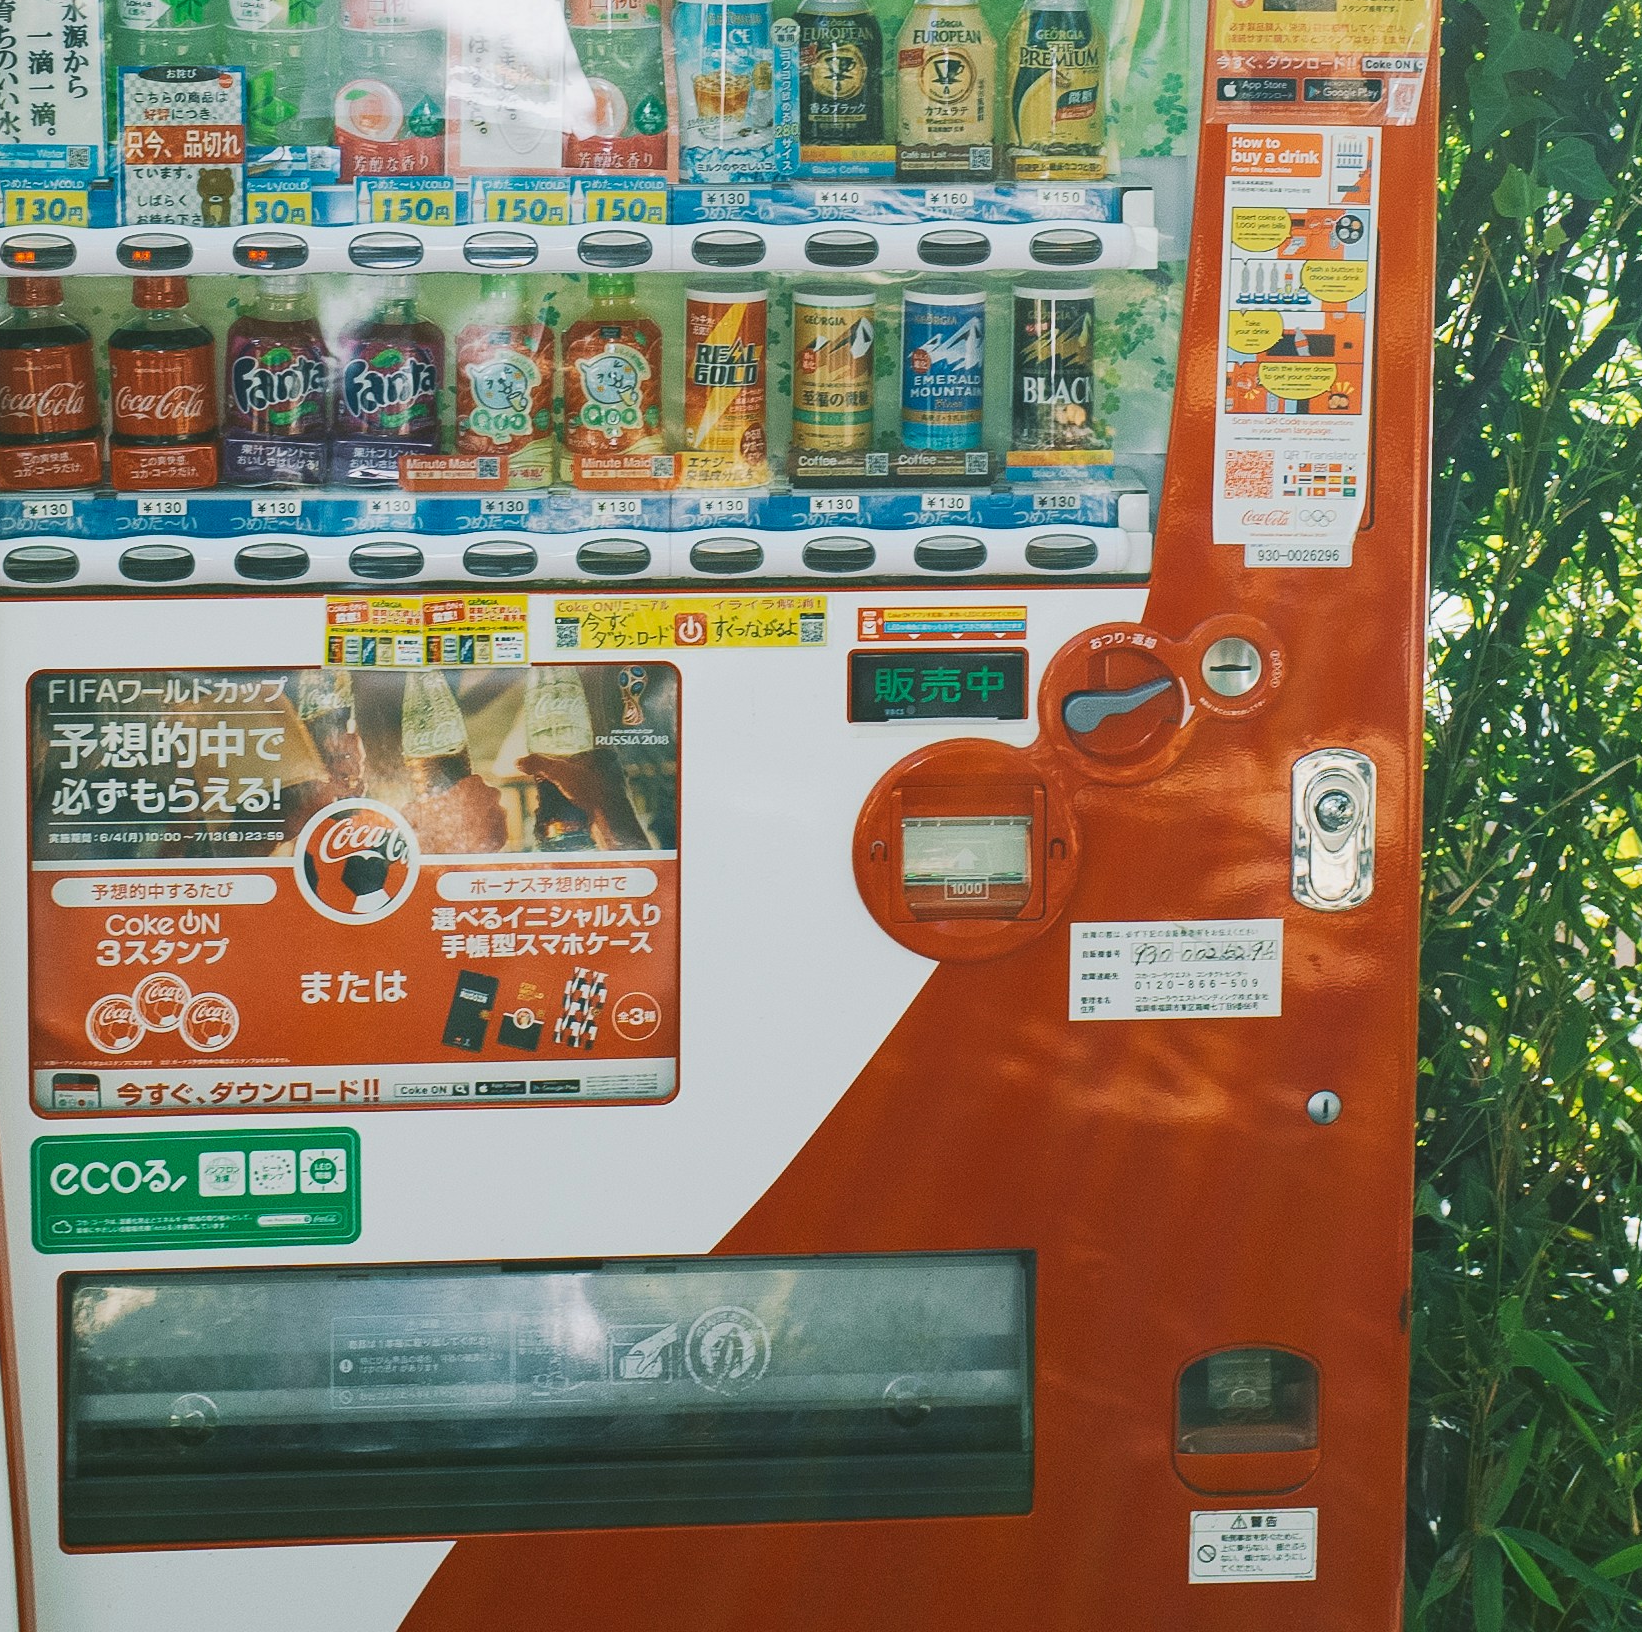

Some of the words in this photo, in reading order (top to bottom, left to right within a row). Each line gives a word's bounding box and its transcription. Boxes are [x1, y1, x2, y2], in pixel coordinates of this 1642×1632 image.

[913, 30, 982, 44] EUROPEAN
[1019, 47, 1099, 66] PREMIUM
[1365, 60, 1393, 69] Coke
[1395, 60, 1410, 68] ON
[167, 69, 197, 78] お詫び
[27, 32, 56, 136] 一滴一滴。
[1241, 81, 1261, 90] App
[1264, 81, 1287, 89] Store
[133, 92, 228, 104] こちらの商品は
[1358, 89, 1378, 99] Play
[925, 106, 968, 116] カフェラテ
[126, 130, 241, 158] 只今、品切れ
[1231, 137, 1263, 148] How
[1265, 137, 1280, 149] to
[1231, 150, 1261, 165] buy
[1265, 152, 1274, 163] a
[1279, 151, 1319, 165] drink
[134, 168, 194, 179] ています。
[137, 195, 187, 206] しばらく
[707, 193, 745, 205] ¥130
[820, 192, 859, 203] ¥140
[930, 193, 967, 204] ¥160
[1043, 192, 1080, 203] ¥150
[15, 197, 83, 222] 130円
[381, 198, 450, 222] 150円
[497, 198, 563, 222] 150円
[595, 197, 662, 222] 150円
[804, 316, 847, 326] GEORGIA
[695, 337, 760, 364] REAL
[694, 364, 757, 386] GOLD
[914, 375, 981, 385] EMERALD
[232, 354, 329, 414] Fanta
[344, 358, 437, 417] Fanta
[116, 385, 206, 419] Coca-Cola
[407, 458, 446, 469] Minute
[448, 458, 477, 468] Maid
[581, 458, 621, 469] Minute
[623, 458, 652, 468] Maid
[688, 457, 734, 467] エナジー
[798, 456, 837, 466] Coffee
[898, 455, 937, 465] Coffee
[143, 502, 181, 514] ¥130
[258, 502, 296, 514] ¥130
[372, 501, 411, 512] ¥130
[485, 501, 524, 512] ¥130
[597, 501, 636, 512] ¥130
[705, 500, 743, 511] ¥130
[815, 499, 853, 510] ¥130
[1038, 496, 1076, 507] ¥130
[29, 503, 68, 516] ¥130
[1242, 509, 1291, 526] Coca-Cola
[1258, 550, 1340, 562] 930-0026296
[557, 601, 589, 613] Coke
[592, 600, 670, 613] ONリニューアル
[582, 613, 635, 630] 今すぐ
[593, 623, 675, 647] ダウンロード
[1090, 631, 1157, 650] おつり・返却
[48, 676, 288, 704] FIFAワールドカップ
[874, 665, 1004, 703] 販売中
[50, 721, 285, 769] 予想的中で
[595, 735, 639, 745] RUSSIA
[641, 734, 669, 745] 2018
[52, 776, 281, 815] 必ずもらえる!
[91, 882, 234, 901] 予想的中するたび
[471, 876, 627, 894] ボーナス予想的中で
[951, 882, 982, 896] 1000
[105, 914, 174, 936] Coke
[178, 909, 220, 936] ON
[431, 903, 661, 931] 選べるイニシャル入り
[97, 938, 229, 966] 3スタンプ
[442, 932, 653, 959] 手帳型スマホケース
[300, 970, 407, 1004] または
[1135, 979, 1259, 989] 0120-866-509
[117, 1078, 380, 1105] 今すぐ、ダウンロード!!
[401, 1085, 427, 1095] Coke
[431, 1085, 447, 1095] ON
